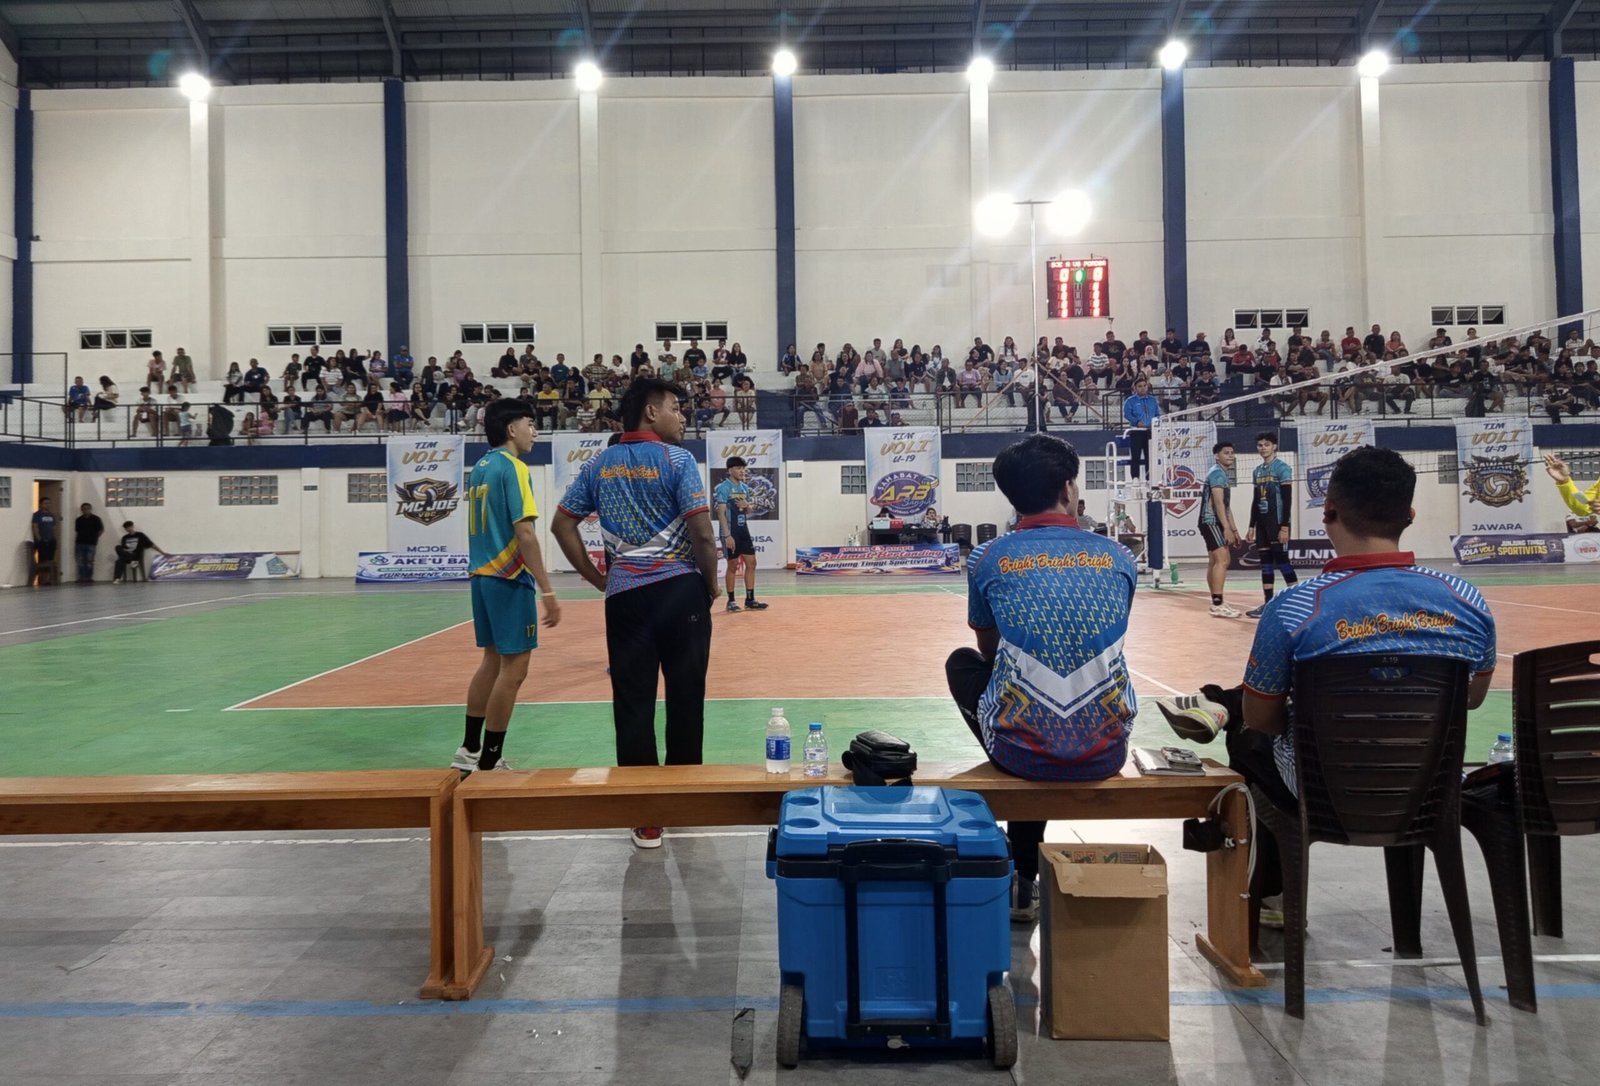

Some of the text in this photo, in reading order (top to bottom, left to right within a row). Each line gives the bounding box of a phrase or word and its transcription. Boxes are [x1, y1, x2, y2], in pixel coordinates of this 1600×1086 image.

[415, 442, 438, 450] TIM
[415, 464, 438, 472] U-19
[878, 472, 919, 490] SAHABAT
[400, 498, 460, 513] MC JOE
[469, 484, 488, 536] 17
[1472, 523, 1522, 531] JAWARA
[1460, 548, 1478, 556] BOLA
[1498, 546, 1548, 556] SPORTIVITAS
[819, 552, 874, 562] Selamat
[822, 558, 938, 568] Junjung Tinggi Sportivitas
[999, 551, 1113, 576] Bright Bright Bright
[1336, 616, 1376, 640] Bright
[1376, 612, 1418, 636] Bright
